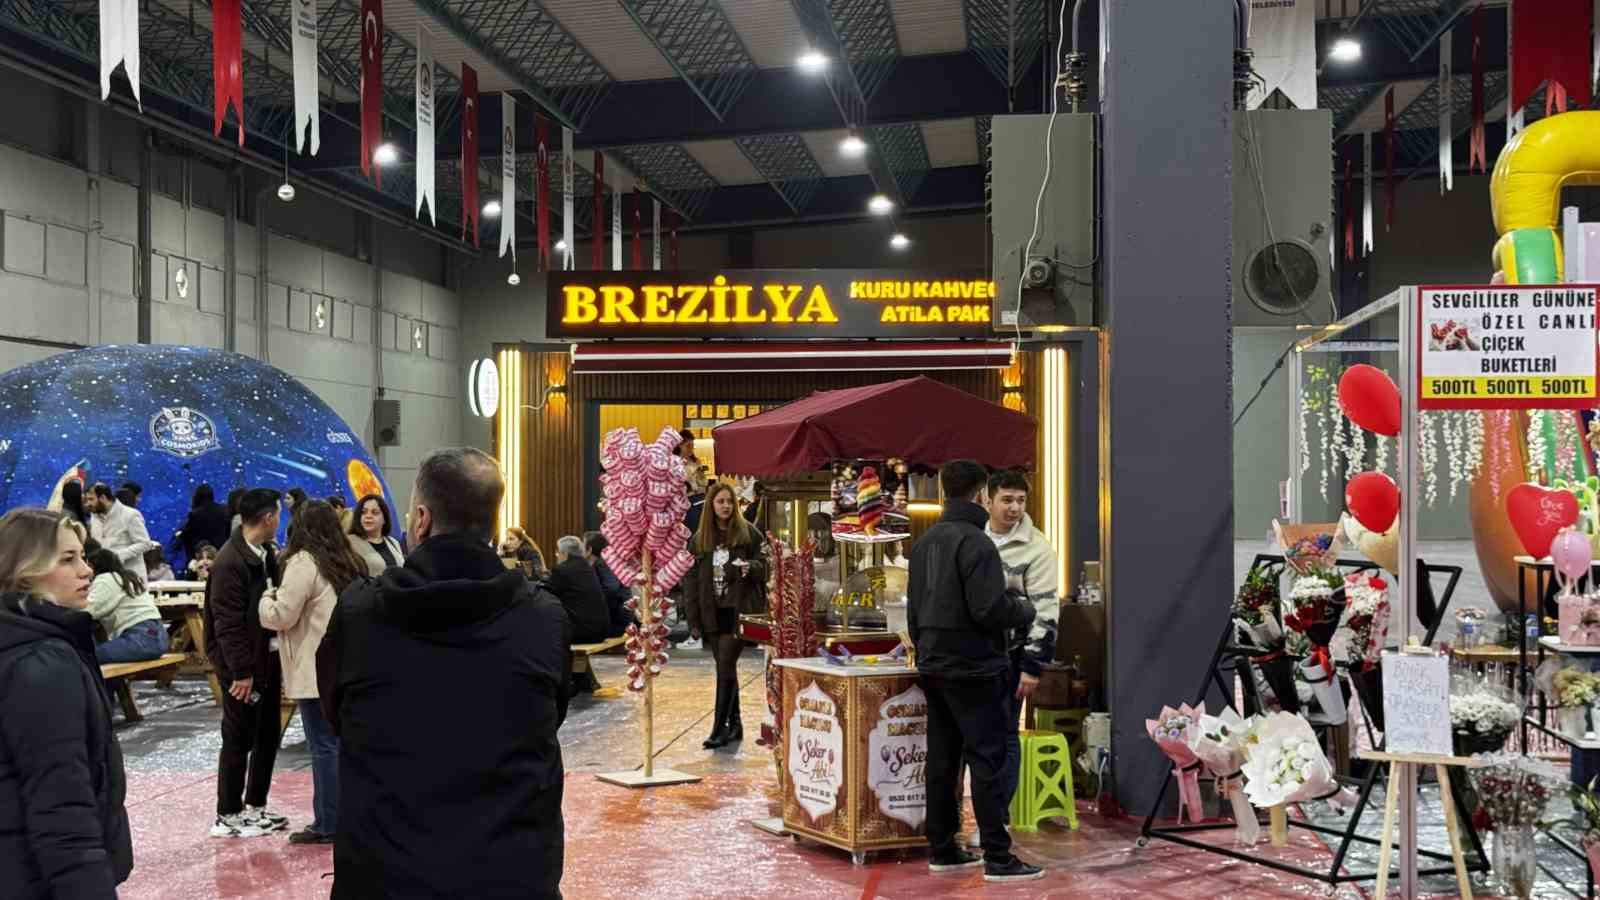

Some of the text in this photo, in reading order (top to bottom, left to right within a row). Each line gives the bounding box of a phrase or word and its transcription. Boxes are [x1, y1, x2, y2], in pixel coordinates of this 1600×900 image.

[850, 280, 910, 299] KURU
[562, 275, 839, 323] BREZİLYA
[1432, 290, 1595, 308] SEVGİLİLER GÜNÜNE
[947, 305, 990, 323] PAK
[1482, 312, 1595, 330] ÖZEL CANLI
[1482, 335, 1525, 355] ÇİÇEK
[1481, 355, 1557, 373] BUKETLERİ
[1432, 379, 1588, 395] 500TL 500TL 500TL
